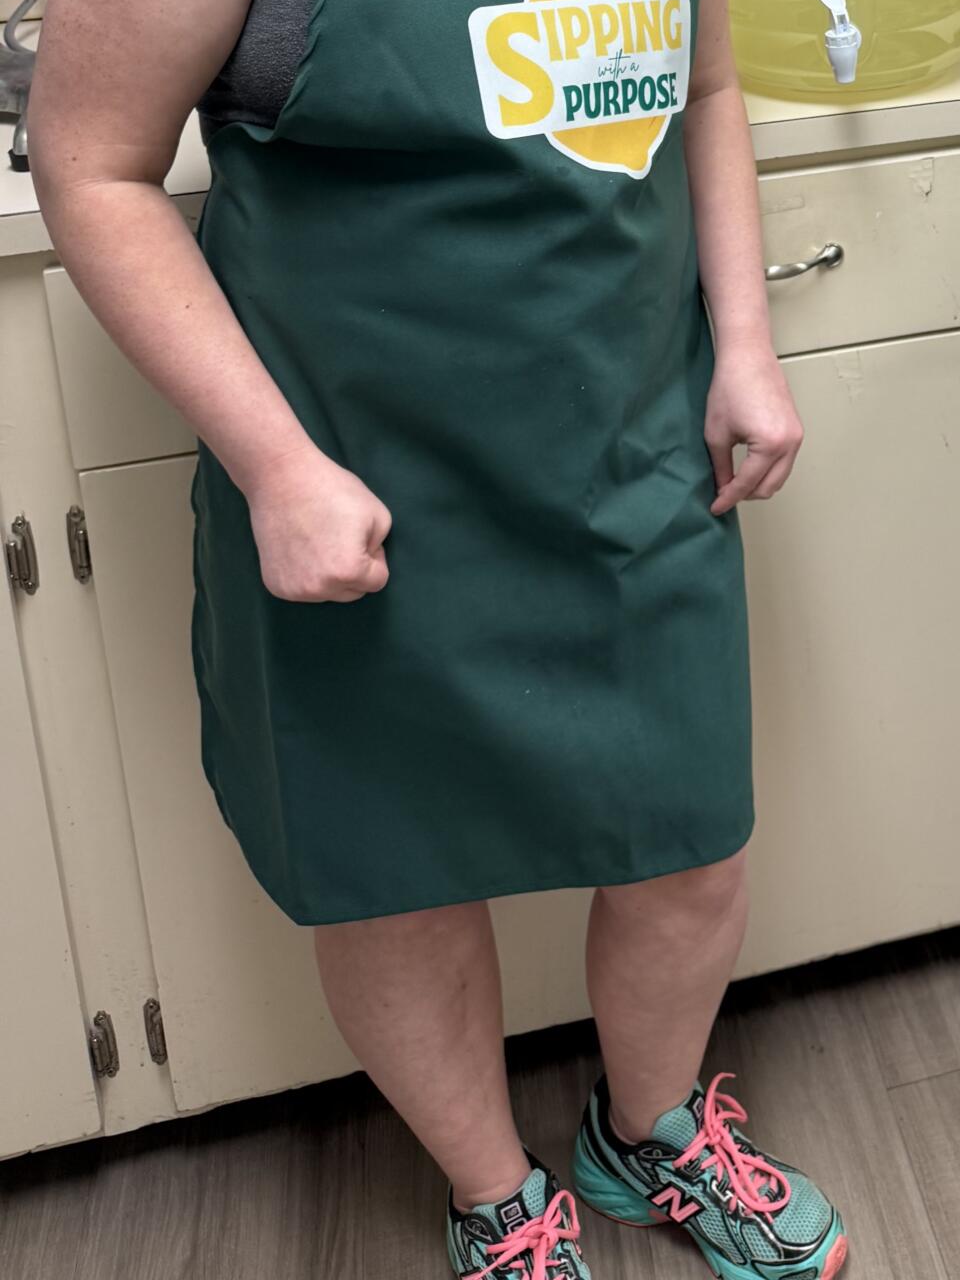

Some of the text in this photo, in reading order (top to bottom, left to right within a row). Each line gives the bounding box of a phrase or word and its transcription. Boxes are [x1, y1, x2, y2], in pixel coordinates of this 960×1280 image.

[598, 48, 640, 81] with a
[562, 72, 678, 123] PURPOSE
